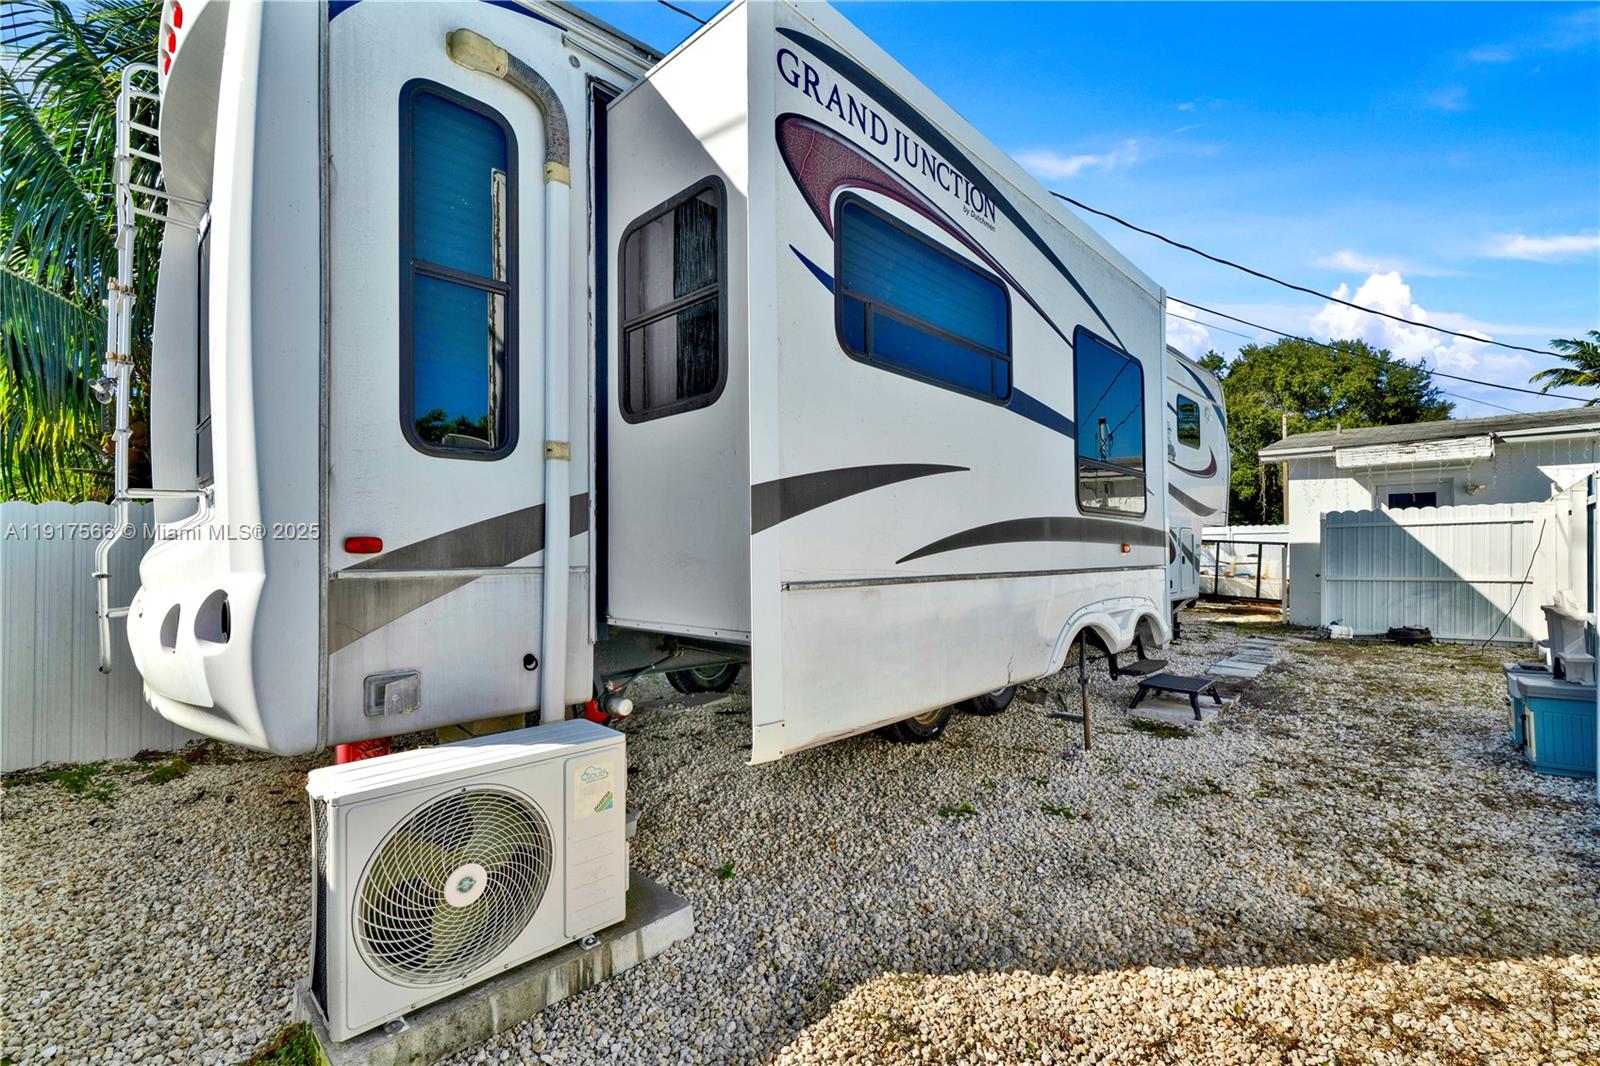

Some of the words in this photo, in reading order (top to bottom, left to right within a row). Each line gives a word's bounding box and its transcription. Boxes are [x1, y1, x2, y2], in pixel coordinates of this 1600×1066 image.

[776, 48, 889, 146] GRAND
[894, 127, 996, 224] JUNCTION
[963, 205, 970, 216] by
[970, 209, 996, 232] Dutchmen
